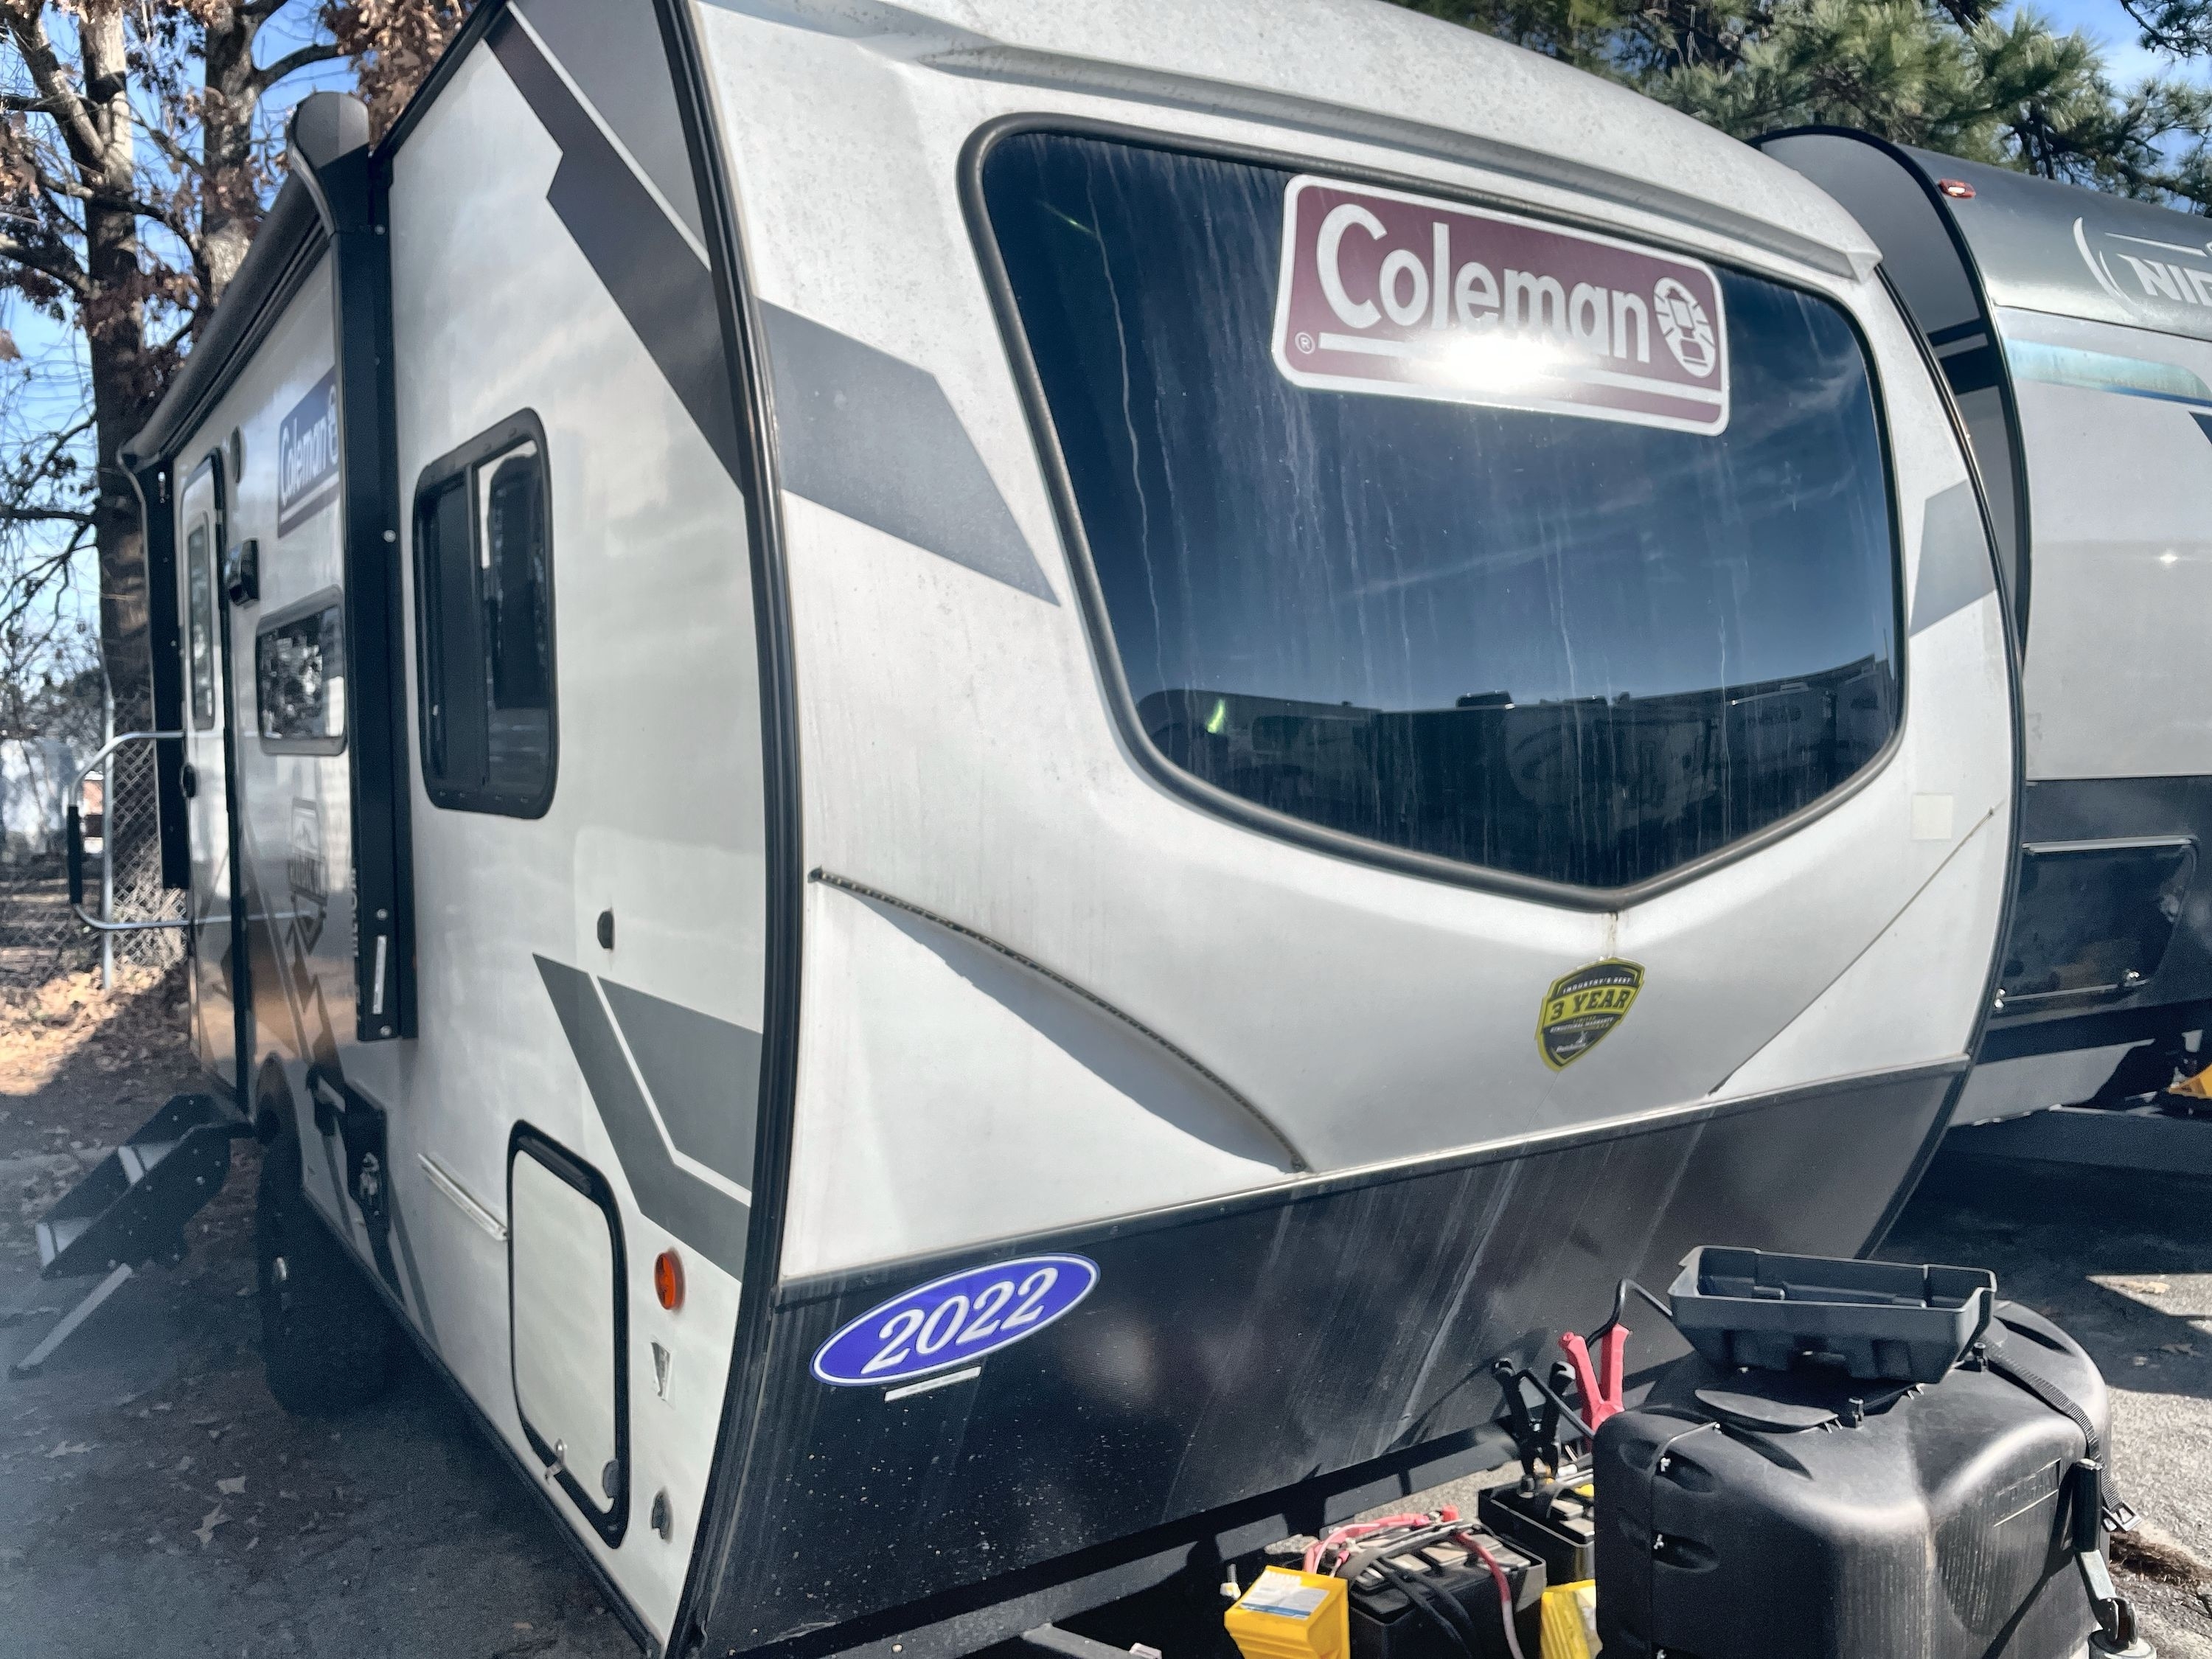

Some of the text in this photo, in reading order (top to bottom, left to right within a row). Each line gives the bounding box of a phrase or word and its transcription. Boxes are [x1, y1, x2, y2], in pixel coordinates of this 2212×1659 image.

[1316, 203, 1650, 364] Coleman
[281, 417, 327, 507] Coleman
[1550, 989, 1631, 1020] 3 YEAR
[860, 1267, 1059, 1375] 2022
